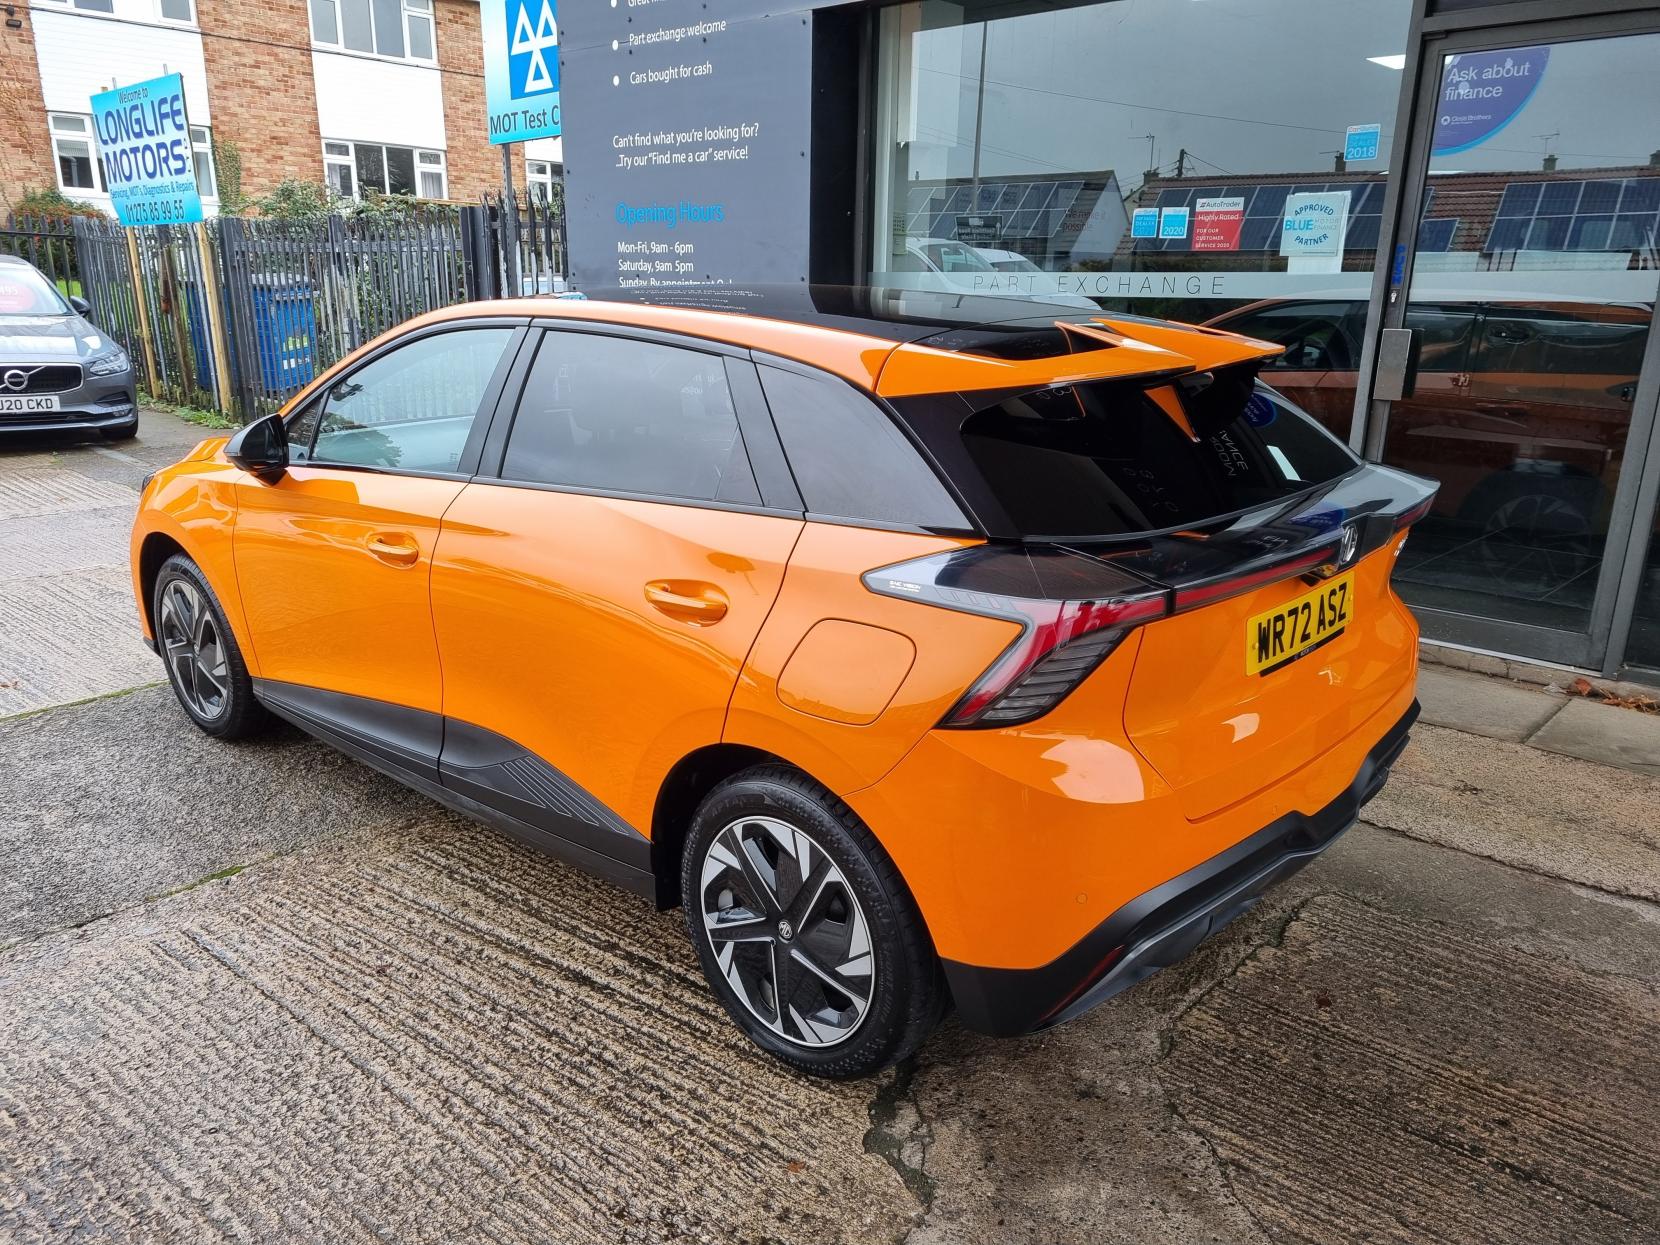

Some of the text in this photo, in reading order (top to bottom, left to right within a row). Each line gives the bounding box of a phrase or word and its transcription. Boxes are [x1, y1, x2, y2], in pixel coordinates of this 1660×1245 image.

[629, 20, 727, 46] Part exchange welcome
[630, 60, 712, 84] Cars bought for cash
[1448, 61, 1531, 83] Ask about
[118, 87, 148, 104] Welcome to
[1445, 86, 1503, 100] finance
[95, 94, 185, 146] LONGLIFE
[490, 104, 560, 135] MOT Test C
[613, 122, 759, 148] Can't find what you're looking for?
[634, 155, 648, 166] our
[649, 151, 671, 165] "Find
[672, 153, 686, 163] me
[687, 152, 693, 162] a
[695, 147, 713, 162] car"
[714, 146, 748, 161] service!
[1347, 146, 1376, 159] 2018
[105, 139, 187, 184] MOTORS
[143, 183, 170, 197] Diagnostics
[170, 181, 175, 193] &
[176, 180, 194, 194] Repairs
[125, 199, 184, 222] 01275 85 99 55
[1206, 200, 1241, 208] AutoTrader
[1294, 203, 1334, 216] APPROVED
[616, 200, 725, 229] Opening Hours
[1198, 213, 1219, 222] Highly
[1164, 226, 1184, 235] 2020
[1284, 219, 1314, 231] BLUE
[1294, 233, 1329, 246] PARTNER
[617, 241, 650, 255] Mon-Fri,
[651, 241, 668, 253] 9am
[675, 241, 694, 256] 6pm
[618, 259, 694, 274] Saturday, 9am 5pm
[973, 275, 1225, 295] PART EXCHANGE
[27, 398, 53, 410] CKD
[1257, 582, 1347, 664] WR72 ASZ
